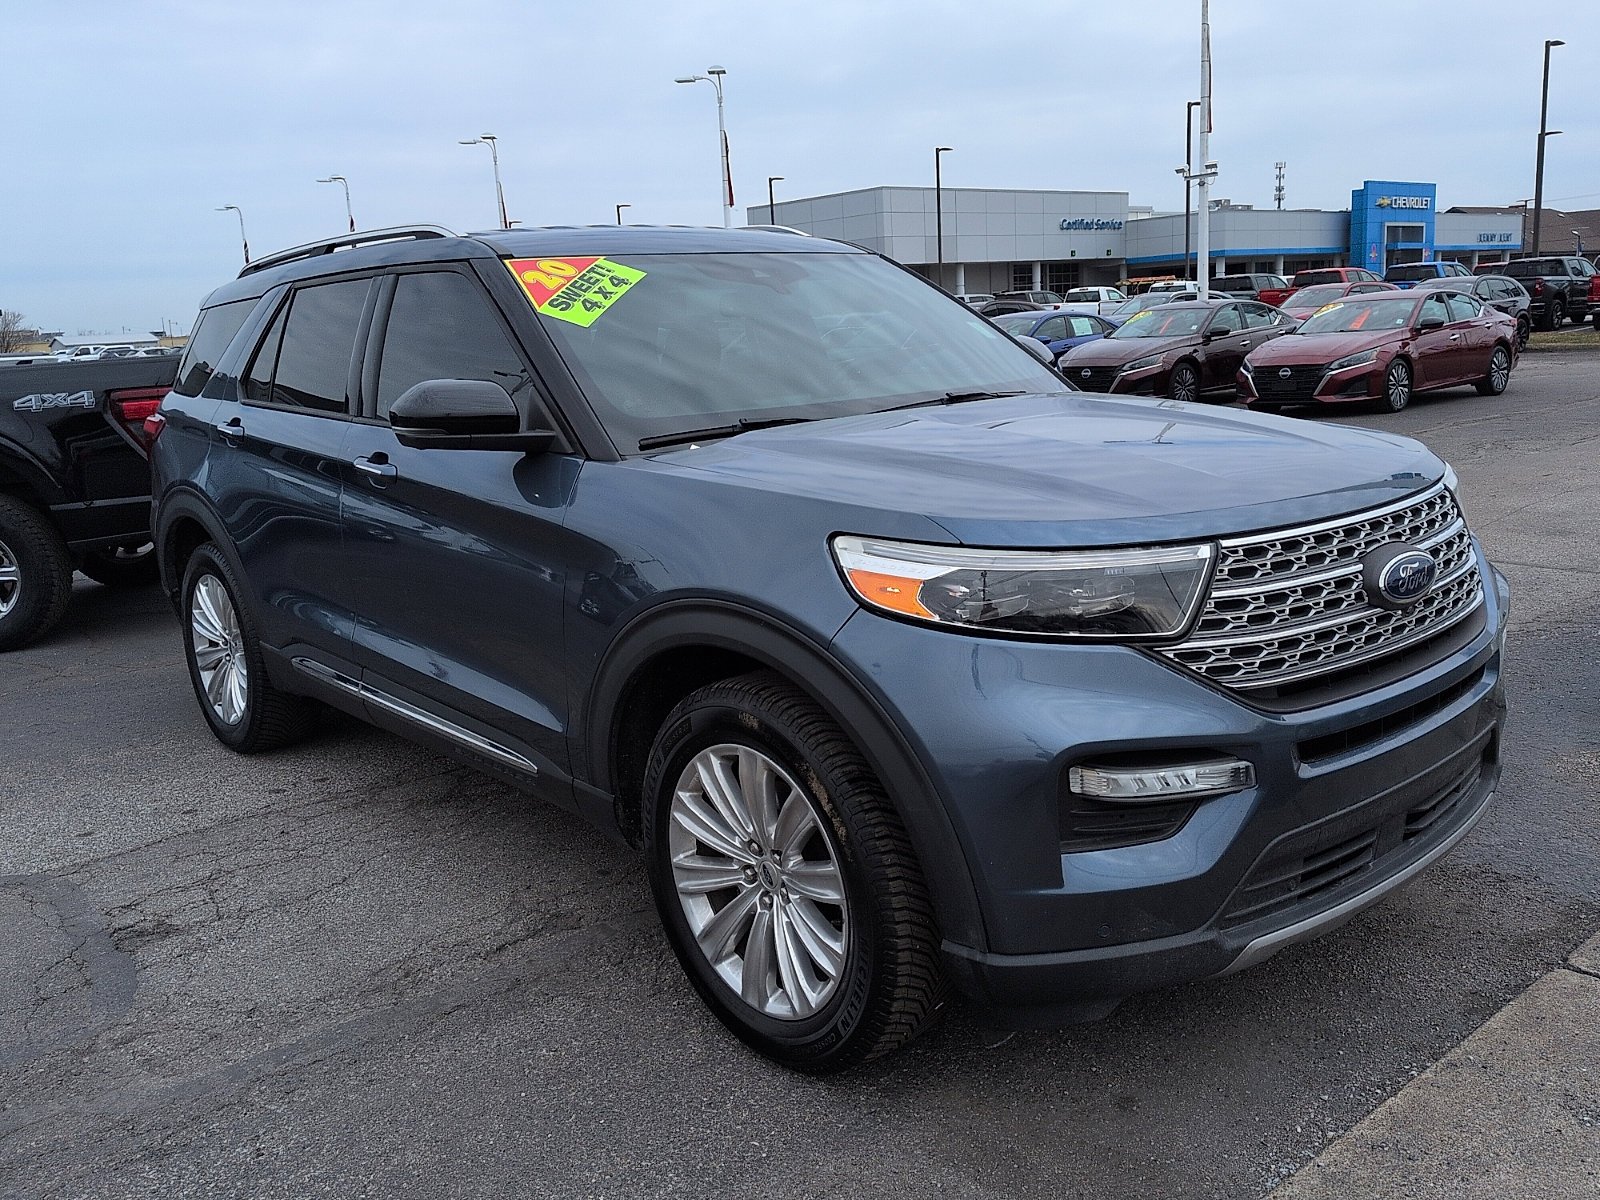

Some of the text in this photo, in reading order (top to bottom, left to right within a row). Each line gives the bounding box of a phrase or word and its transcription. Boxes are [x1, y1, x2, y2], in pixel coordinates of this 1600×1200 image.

[1391, 197, 1431, 209] CHEVROLET
[1060, 218, 1123, 230] Certified Service
[521, 259, 579, 290] 20
[548, 263, 615, 312] SWEET!
[1399, 561, 1430, 592] Ford
